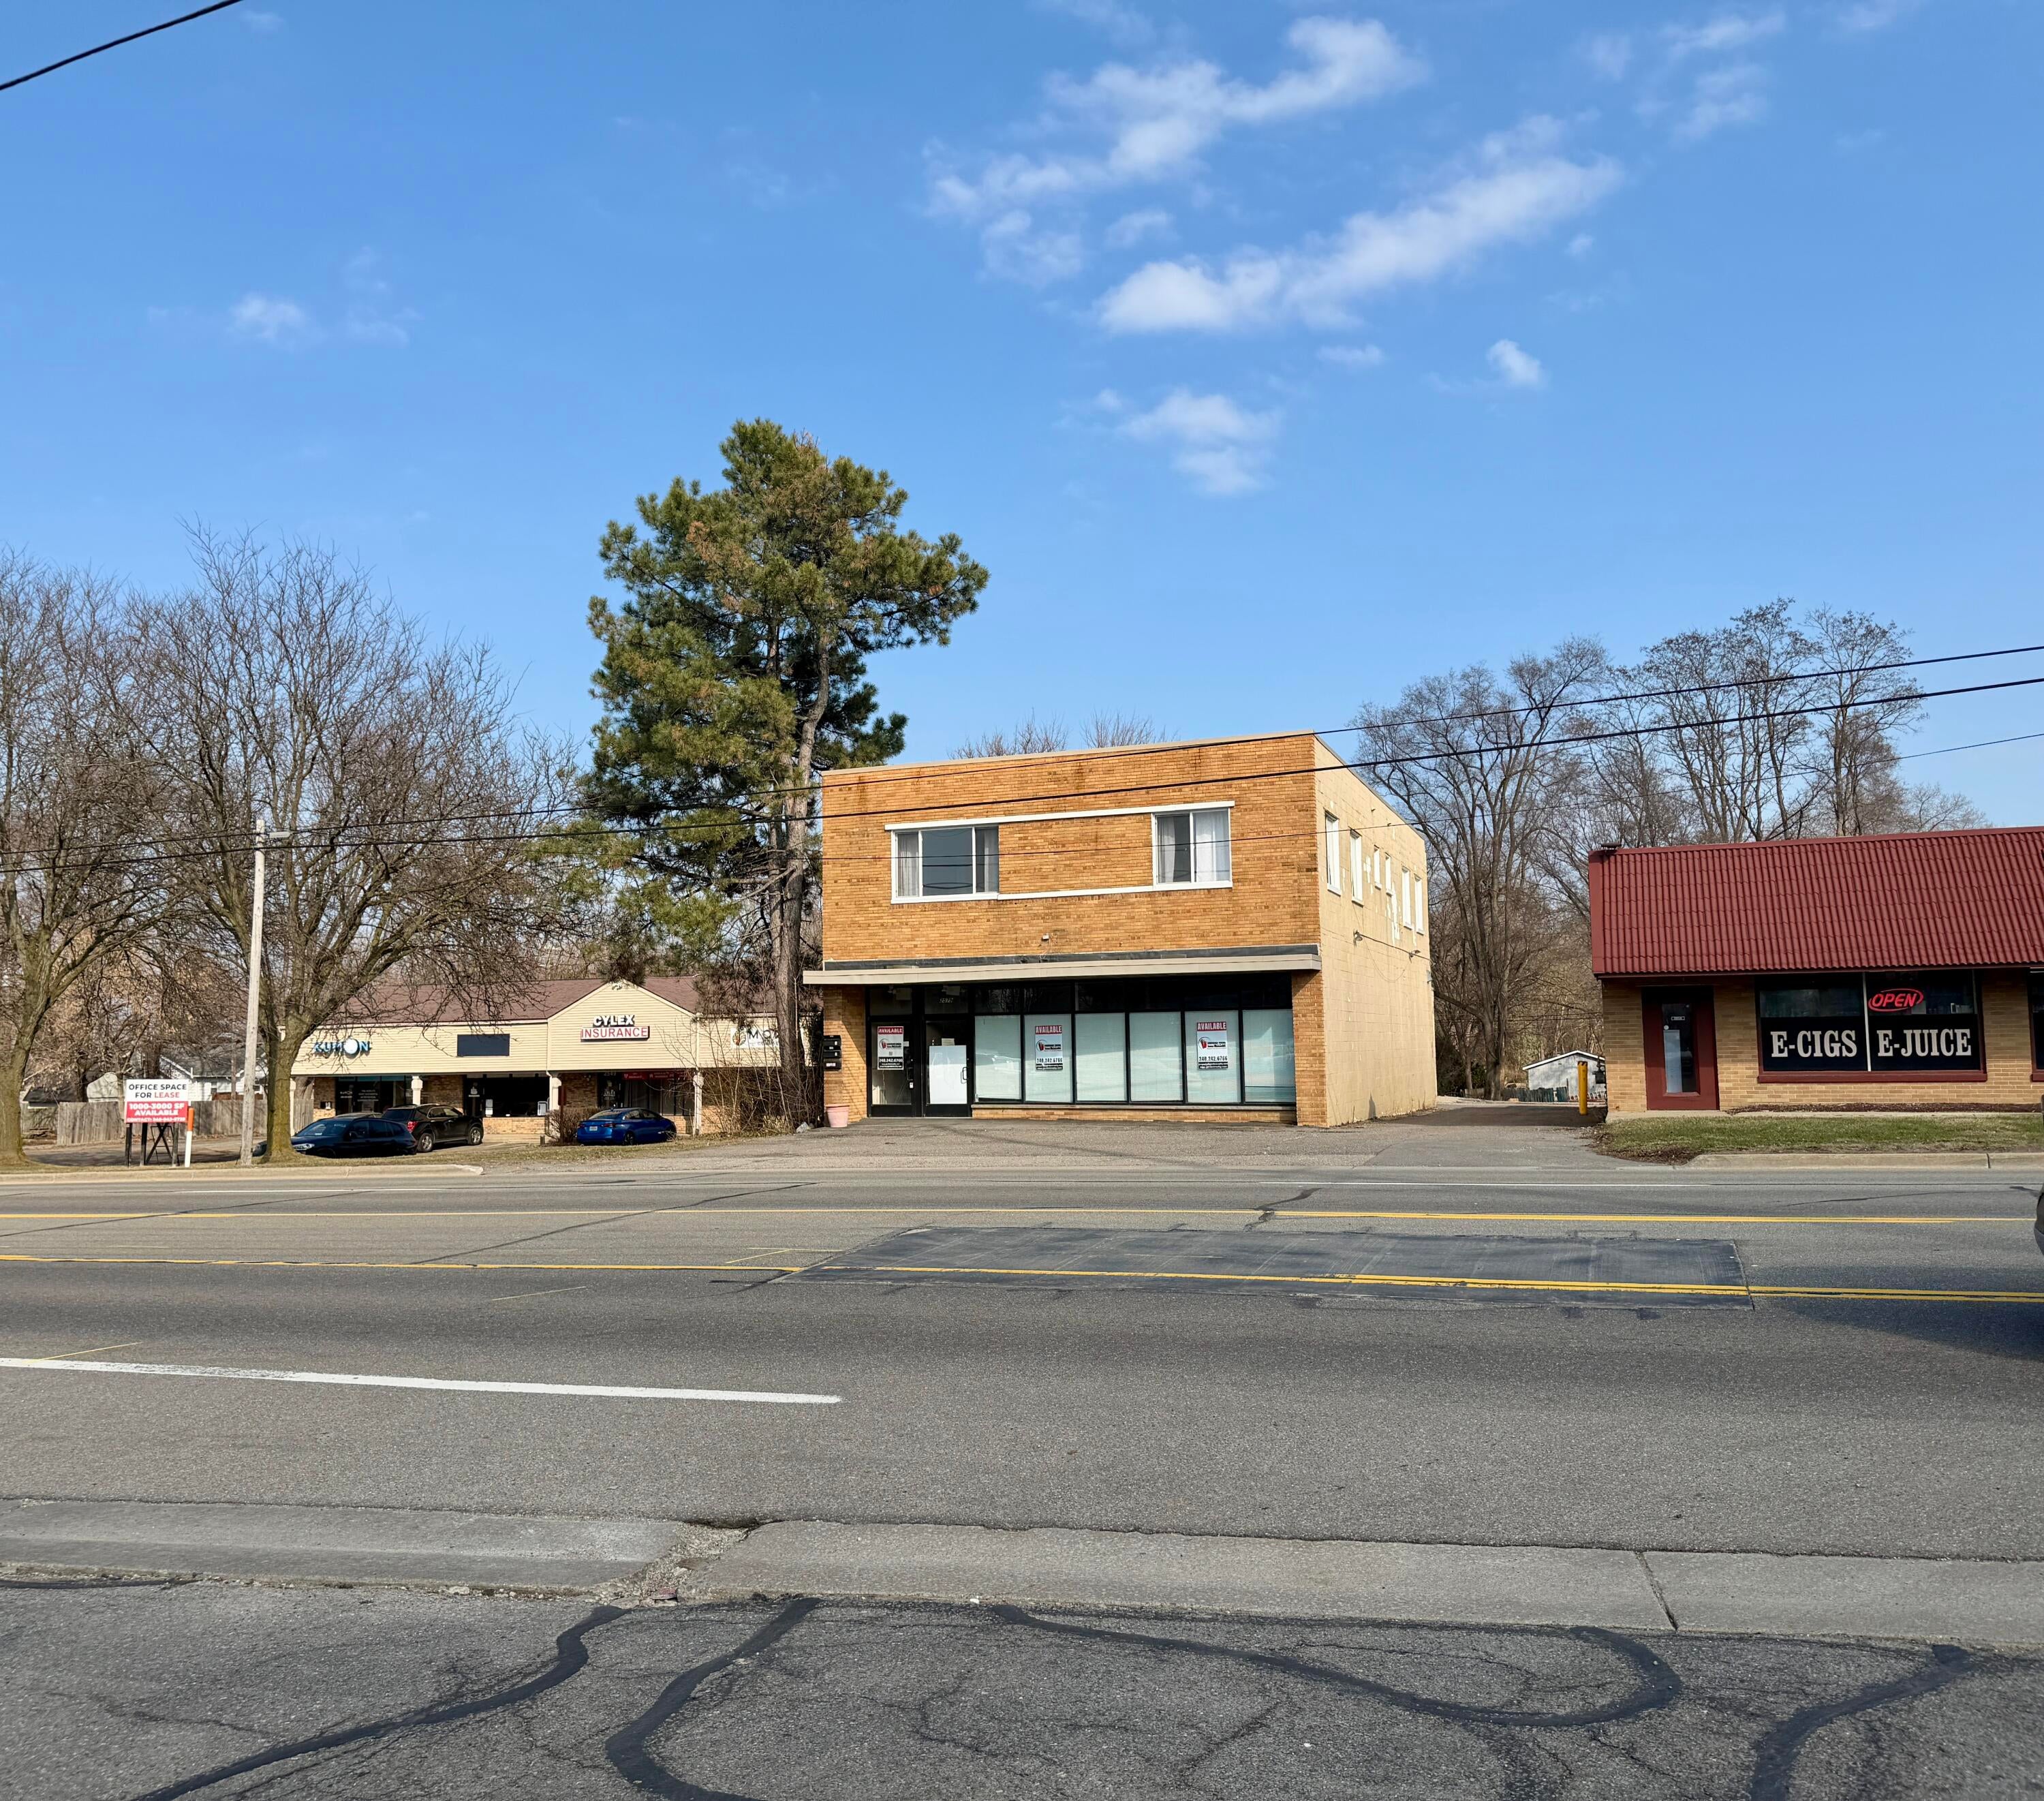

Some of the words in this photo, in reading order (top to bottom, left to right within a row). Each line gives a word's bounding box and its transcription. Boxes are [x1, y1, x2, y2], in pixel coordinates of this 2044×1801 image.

[1872, 993, 1918, 1008] OPEN
[593, 1015, 635, 1026] CYLEX
[1198, 1022, 1226, 1030] AVAILABLE
[580, 1027, 648, 1038] INSURANCE
[314, 1038, 371, 1056] KUMON
[1770, 1030, 1857, 1058] E-CIGS
[1876, 1028, 1972, 1057] E-JUICE
